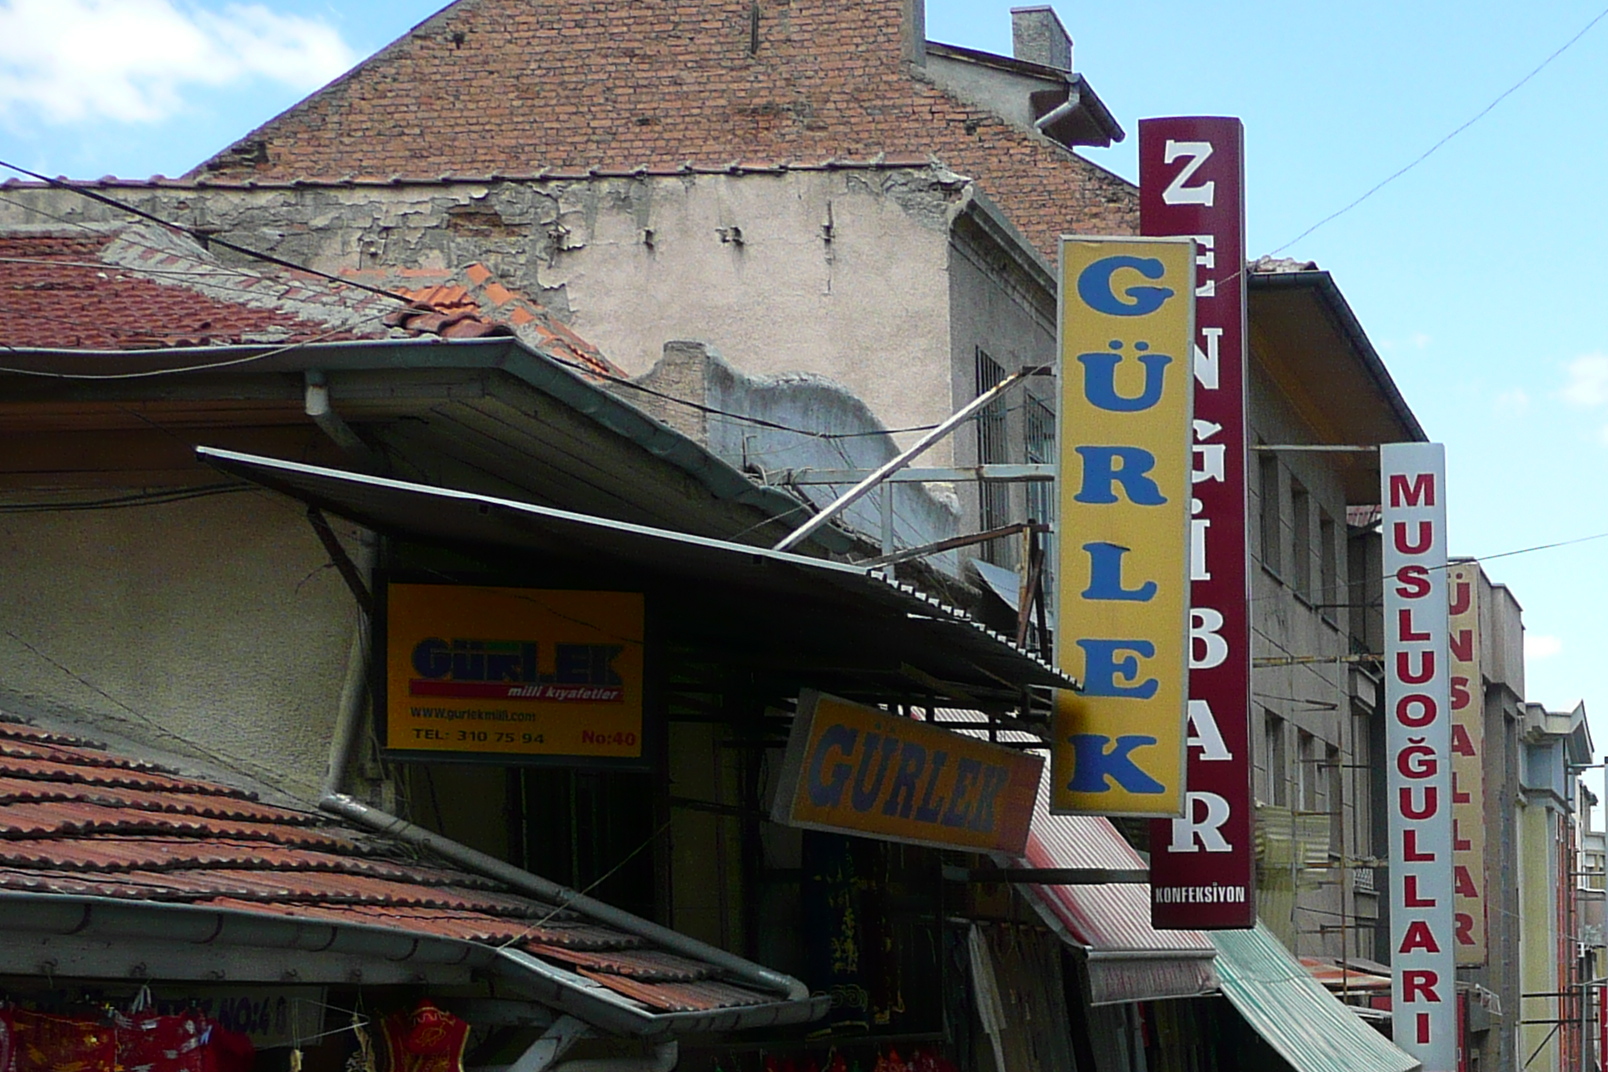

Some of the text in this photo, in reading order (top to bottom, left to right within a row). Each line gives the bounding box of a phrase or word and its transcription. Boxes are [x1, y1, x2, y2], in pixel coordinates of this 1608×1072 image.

[1067, 256, 1175, 794] GÜRLEK
[457, 730, 488, 742] 310
[495, 732, 515, 743] 75
[522, 733, 545, 744] 94
[581, 730, 637, 747] No:40
[1388, 473, 1441, 1044] MUSLUOĞULLARI
[807, 721, 1010, 834] GÜRLEK
[1155, 882, 1245, 903] KONFEKSİYON
